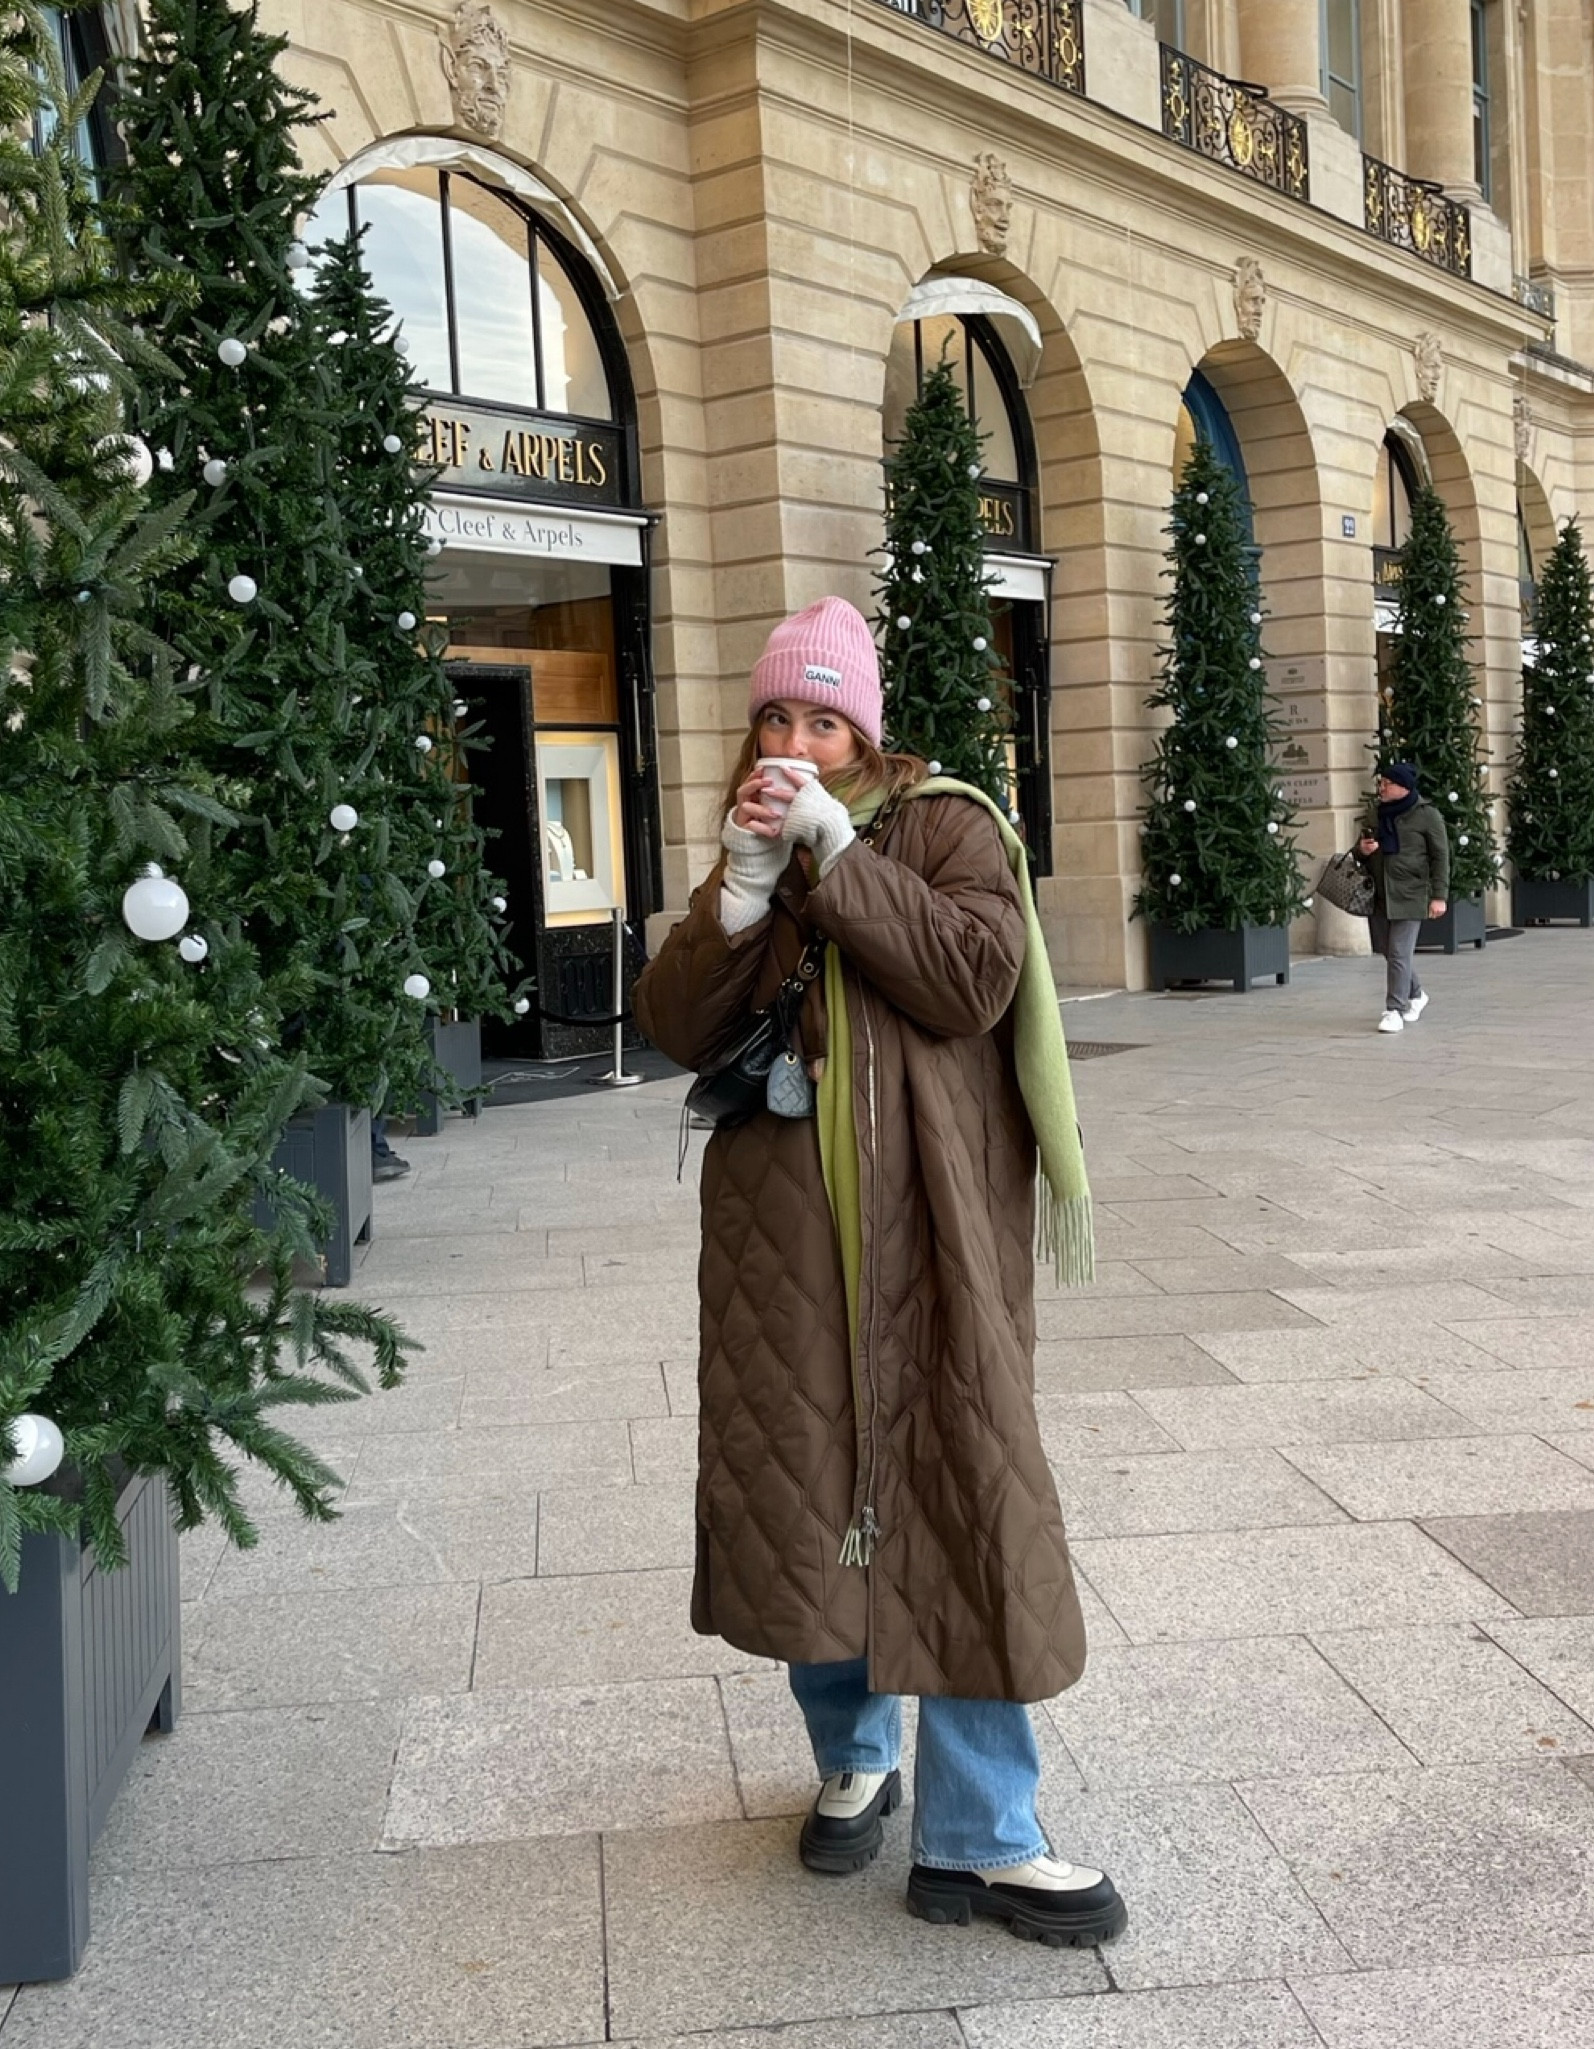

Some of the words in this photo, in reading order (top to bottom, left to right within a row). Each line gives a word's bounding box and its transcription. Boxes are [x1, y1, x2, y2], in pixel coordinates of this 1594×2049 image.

[411, 418, 470, 467] EEF
[480, 447, 495, 471] &
[501, 429, 606, 487] ARPELS
[438, 508, 495, 538] Cleef
[502, 521, 516, 541] &
[524, 519, 583, 552] Arpels
[805, 670, 840, 688] GANNI
